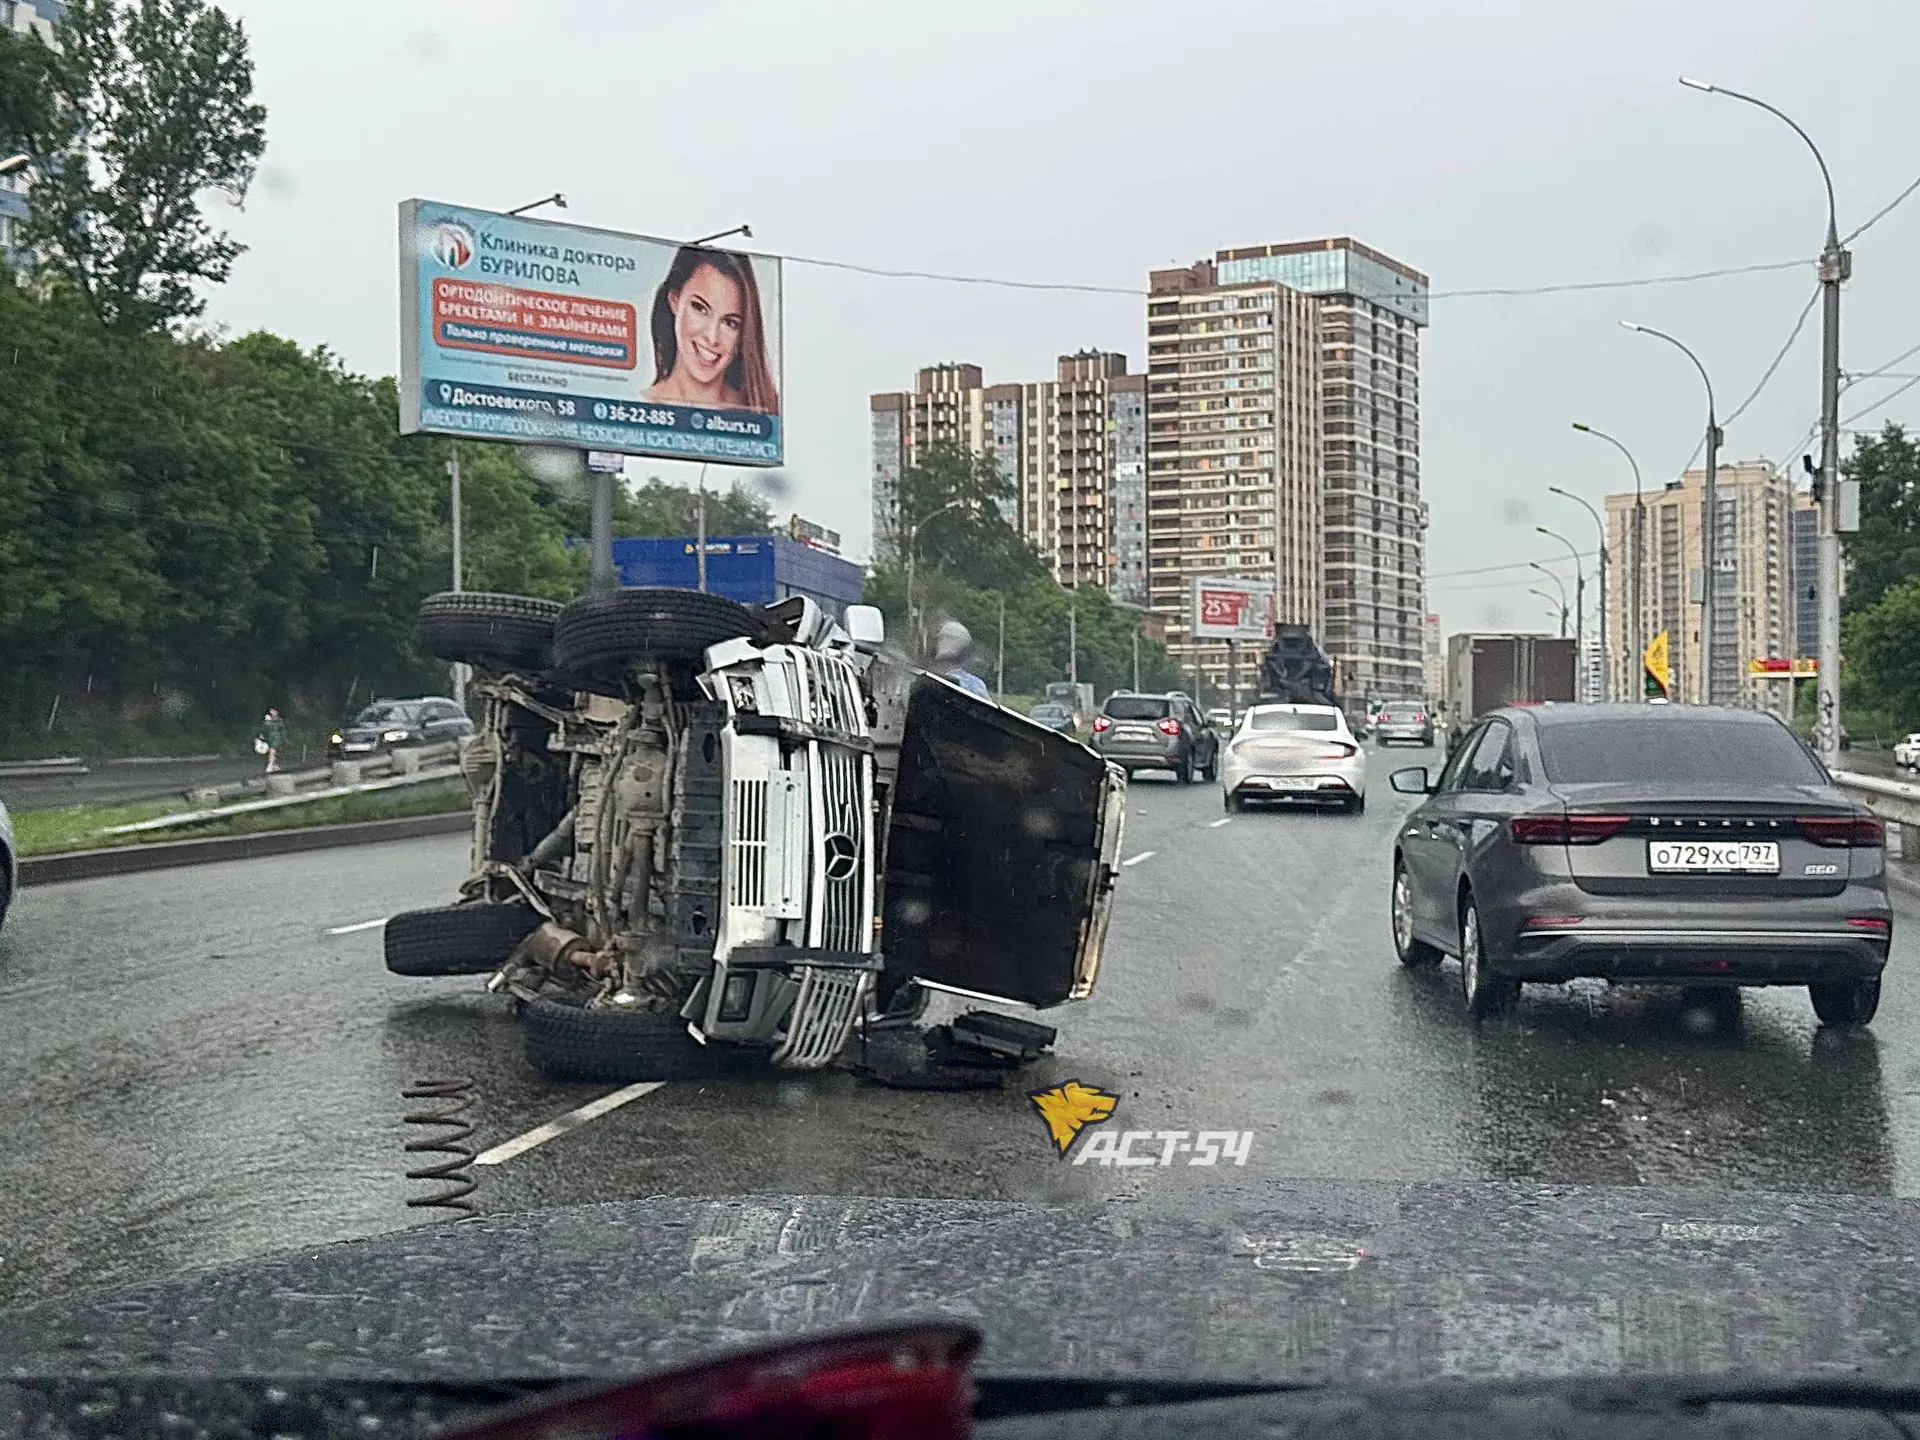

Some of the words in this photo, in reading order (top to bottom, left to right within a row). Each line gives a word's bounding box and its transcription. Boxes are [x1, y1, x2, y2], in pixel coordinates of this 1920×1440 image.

[480, 232, 558, 260] Клиника
[562, 247, 636, 273] доктора
[480, 255, 580, 286] БУРИЛОВА
[438, 300, 518, 324] БРЕКЕТАМИ
[522, 312, 534, 327] И
[451, 388, 556, 416] Достоевского,
[557, 399, 576, 416] 58
[608, 404, 676, 427] 36-22-885
[705, 415, 762, 435] alburs.ru
[1657, 845, 1738, 866] О729ХС
[1741, 844, 1774, 862] 797
